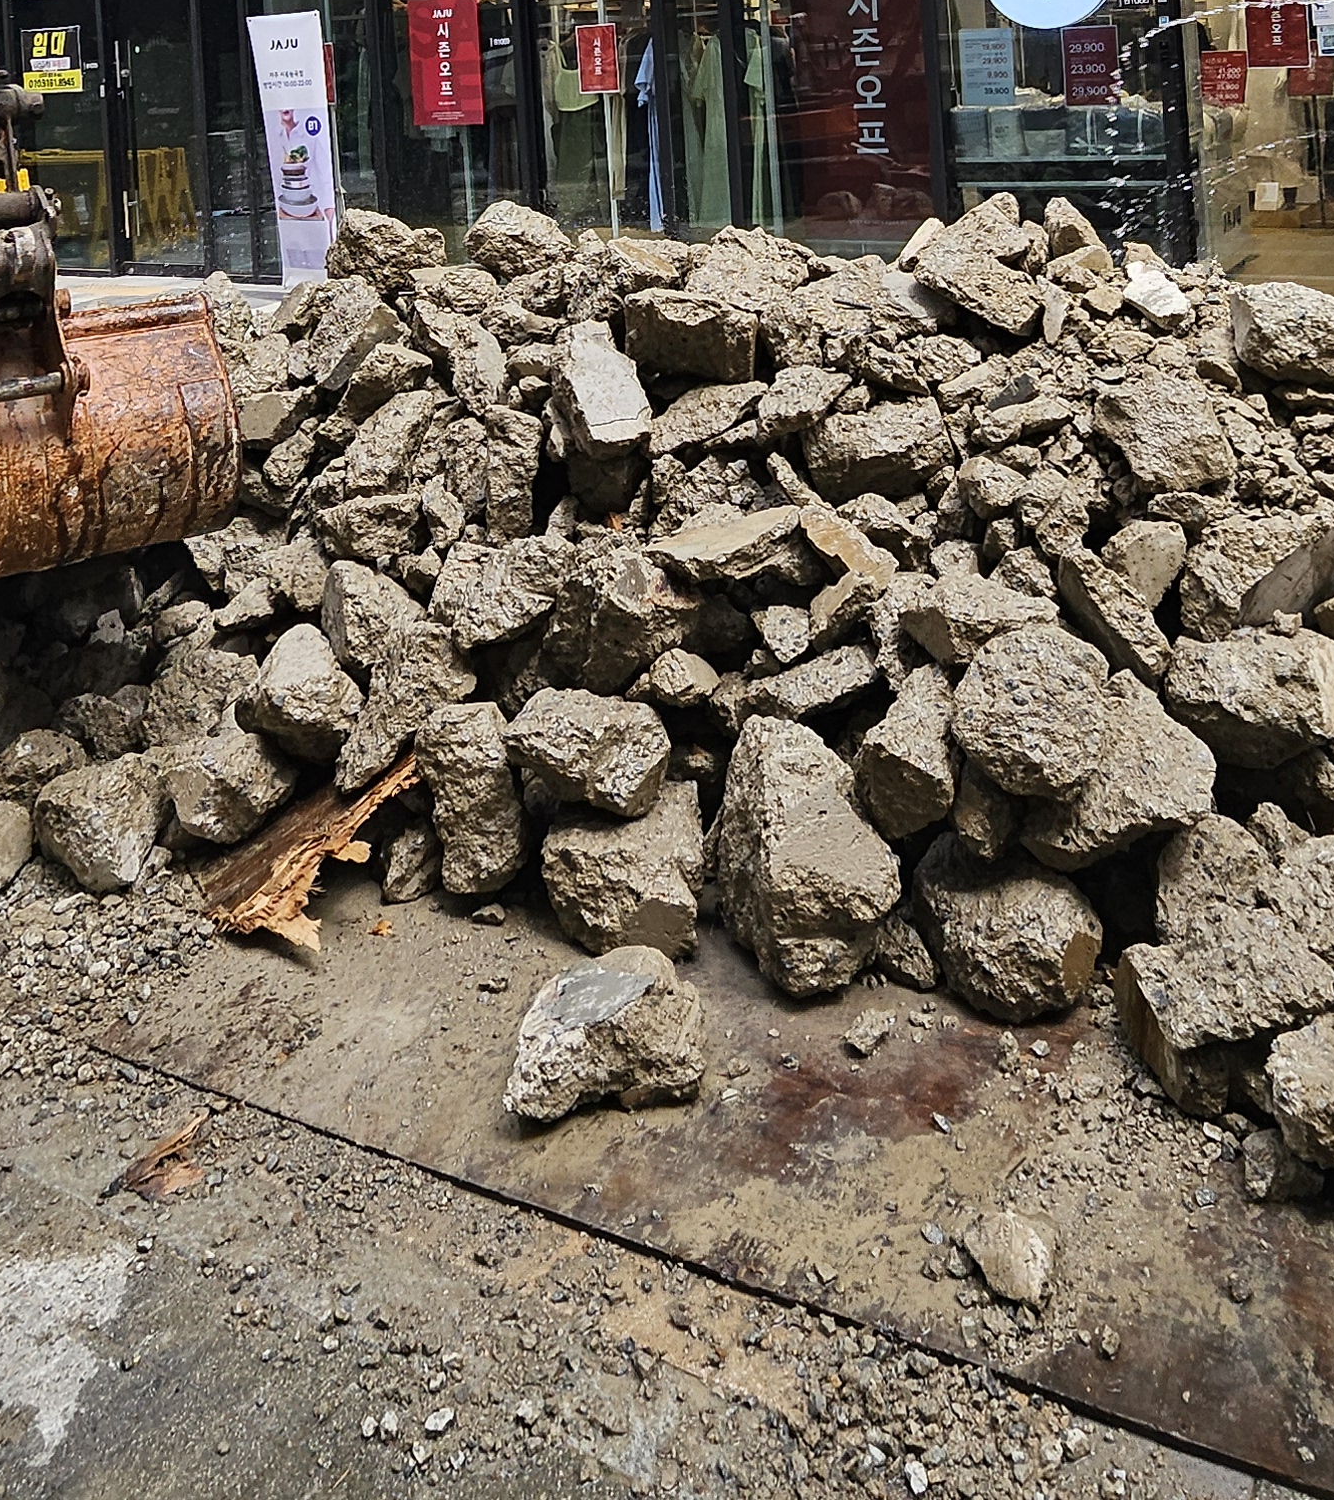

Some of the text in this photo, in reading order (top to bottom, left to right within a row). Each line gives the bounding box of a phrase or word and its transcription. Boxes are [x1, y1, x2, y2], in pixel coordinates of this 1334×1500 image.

[432, 8, 453, 19] JAJU
[32, 31, 67, 58] 임대
[269, 38, 299, 51] JAJU
[436, 21, 454, 96] 시즌오프
[1070, 63, 1107, 75] 23,900
